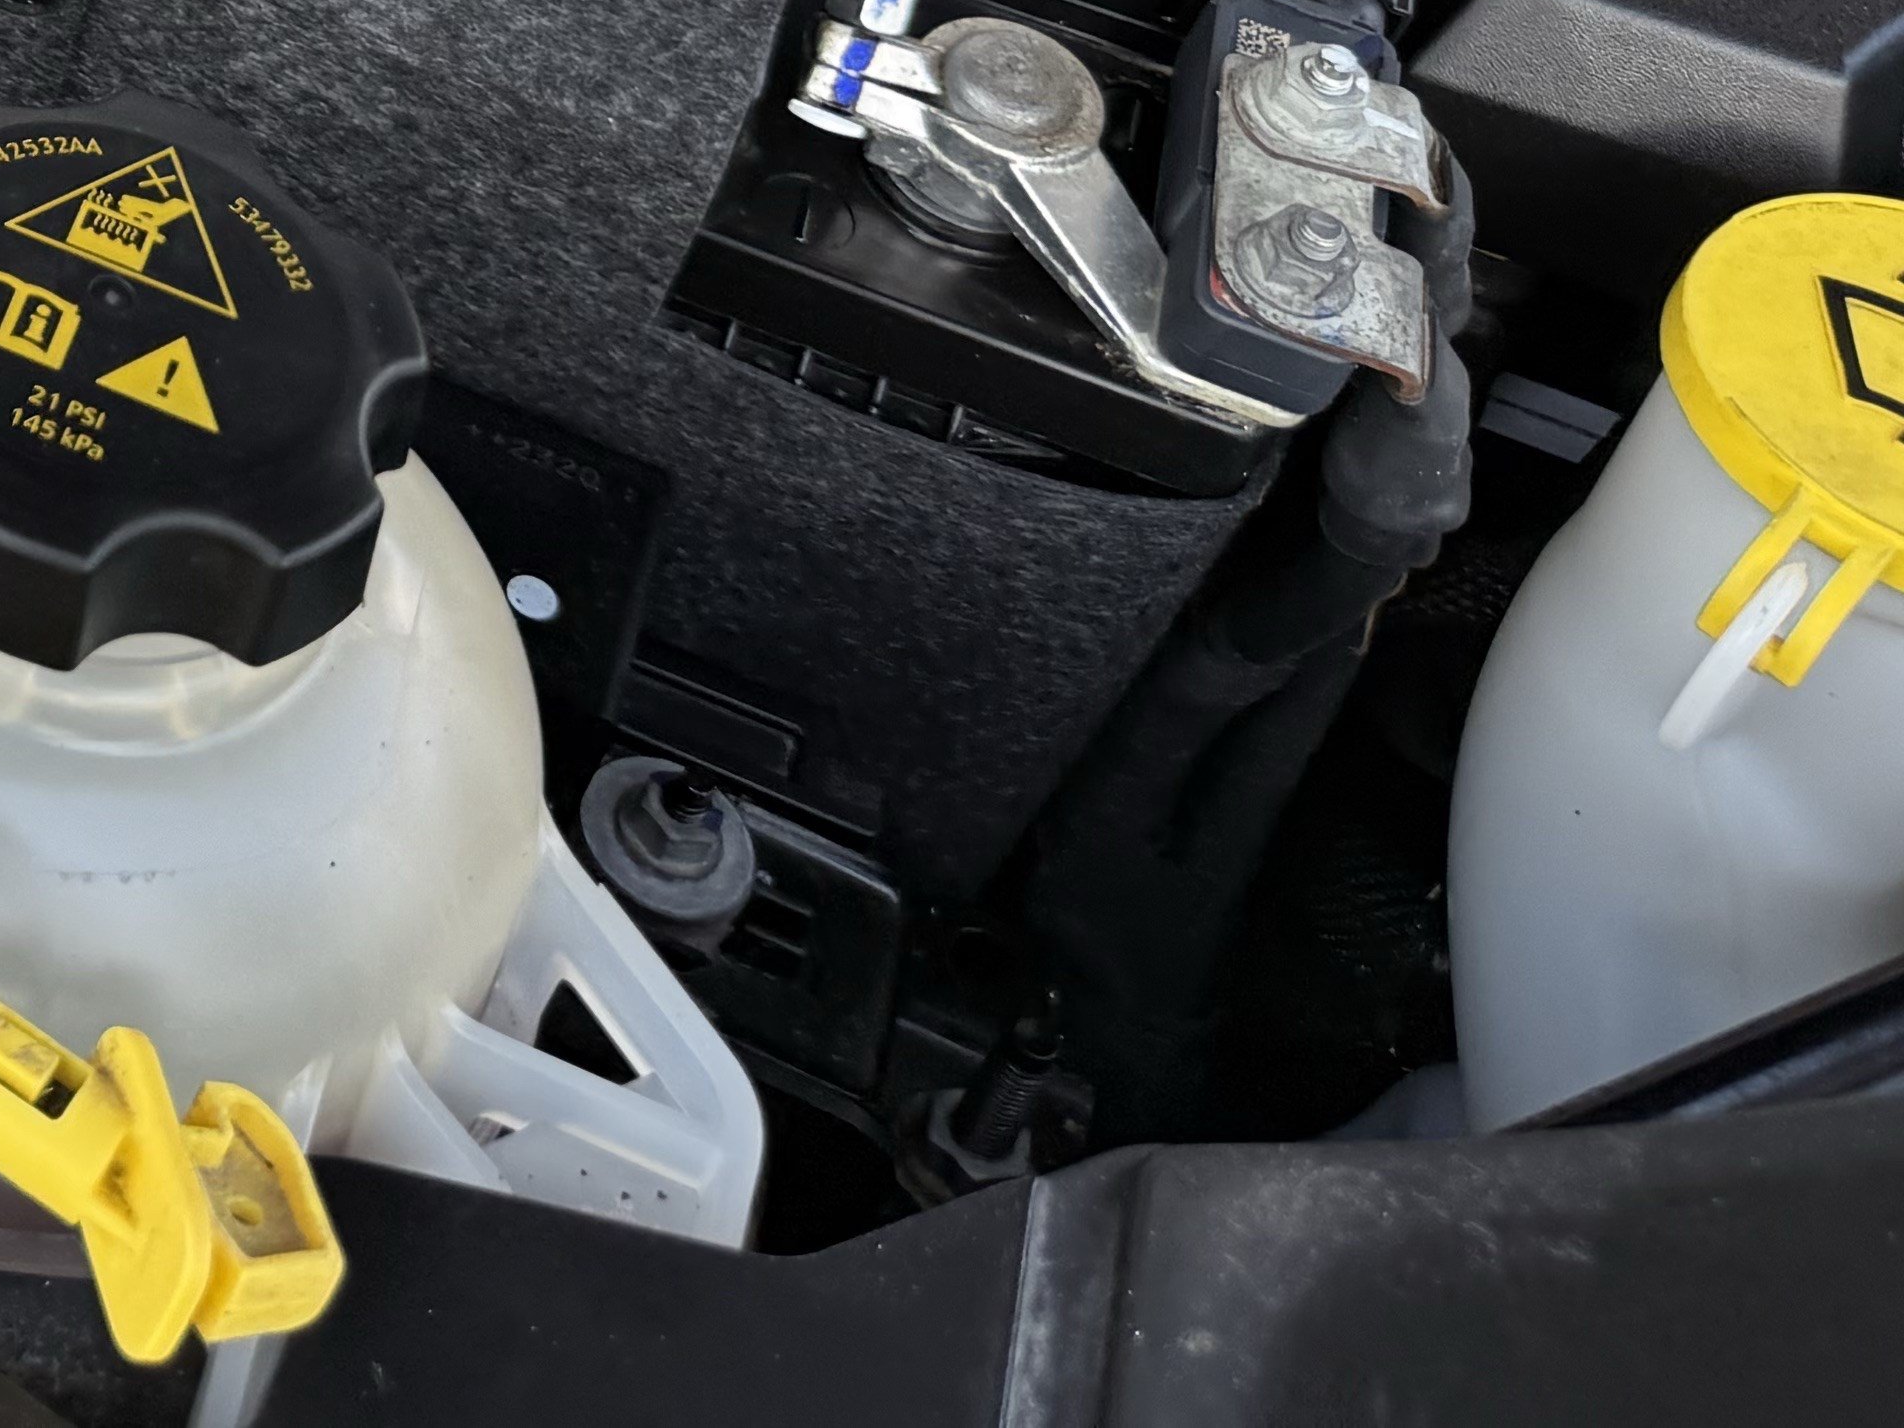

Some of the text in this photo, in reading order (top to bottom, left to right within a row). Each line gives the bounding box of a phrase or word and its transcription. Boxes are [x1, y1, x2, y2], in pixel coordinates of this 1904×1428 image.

[228, 196, 314, 292] 53479332
[27, 384, 106, 431] 21 PSI
[11, 408, 104, 462] 145 kPa
